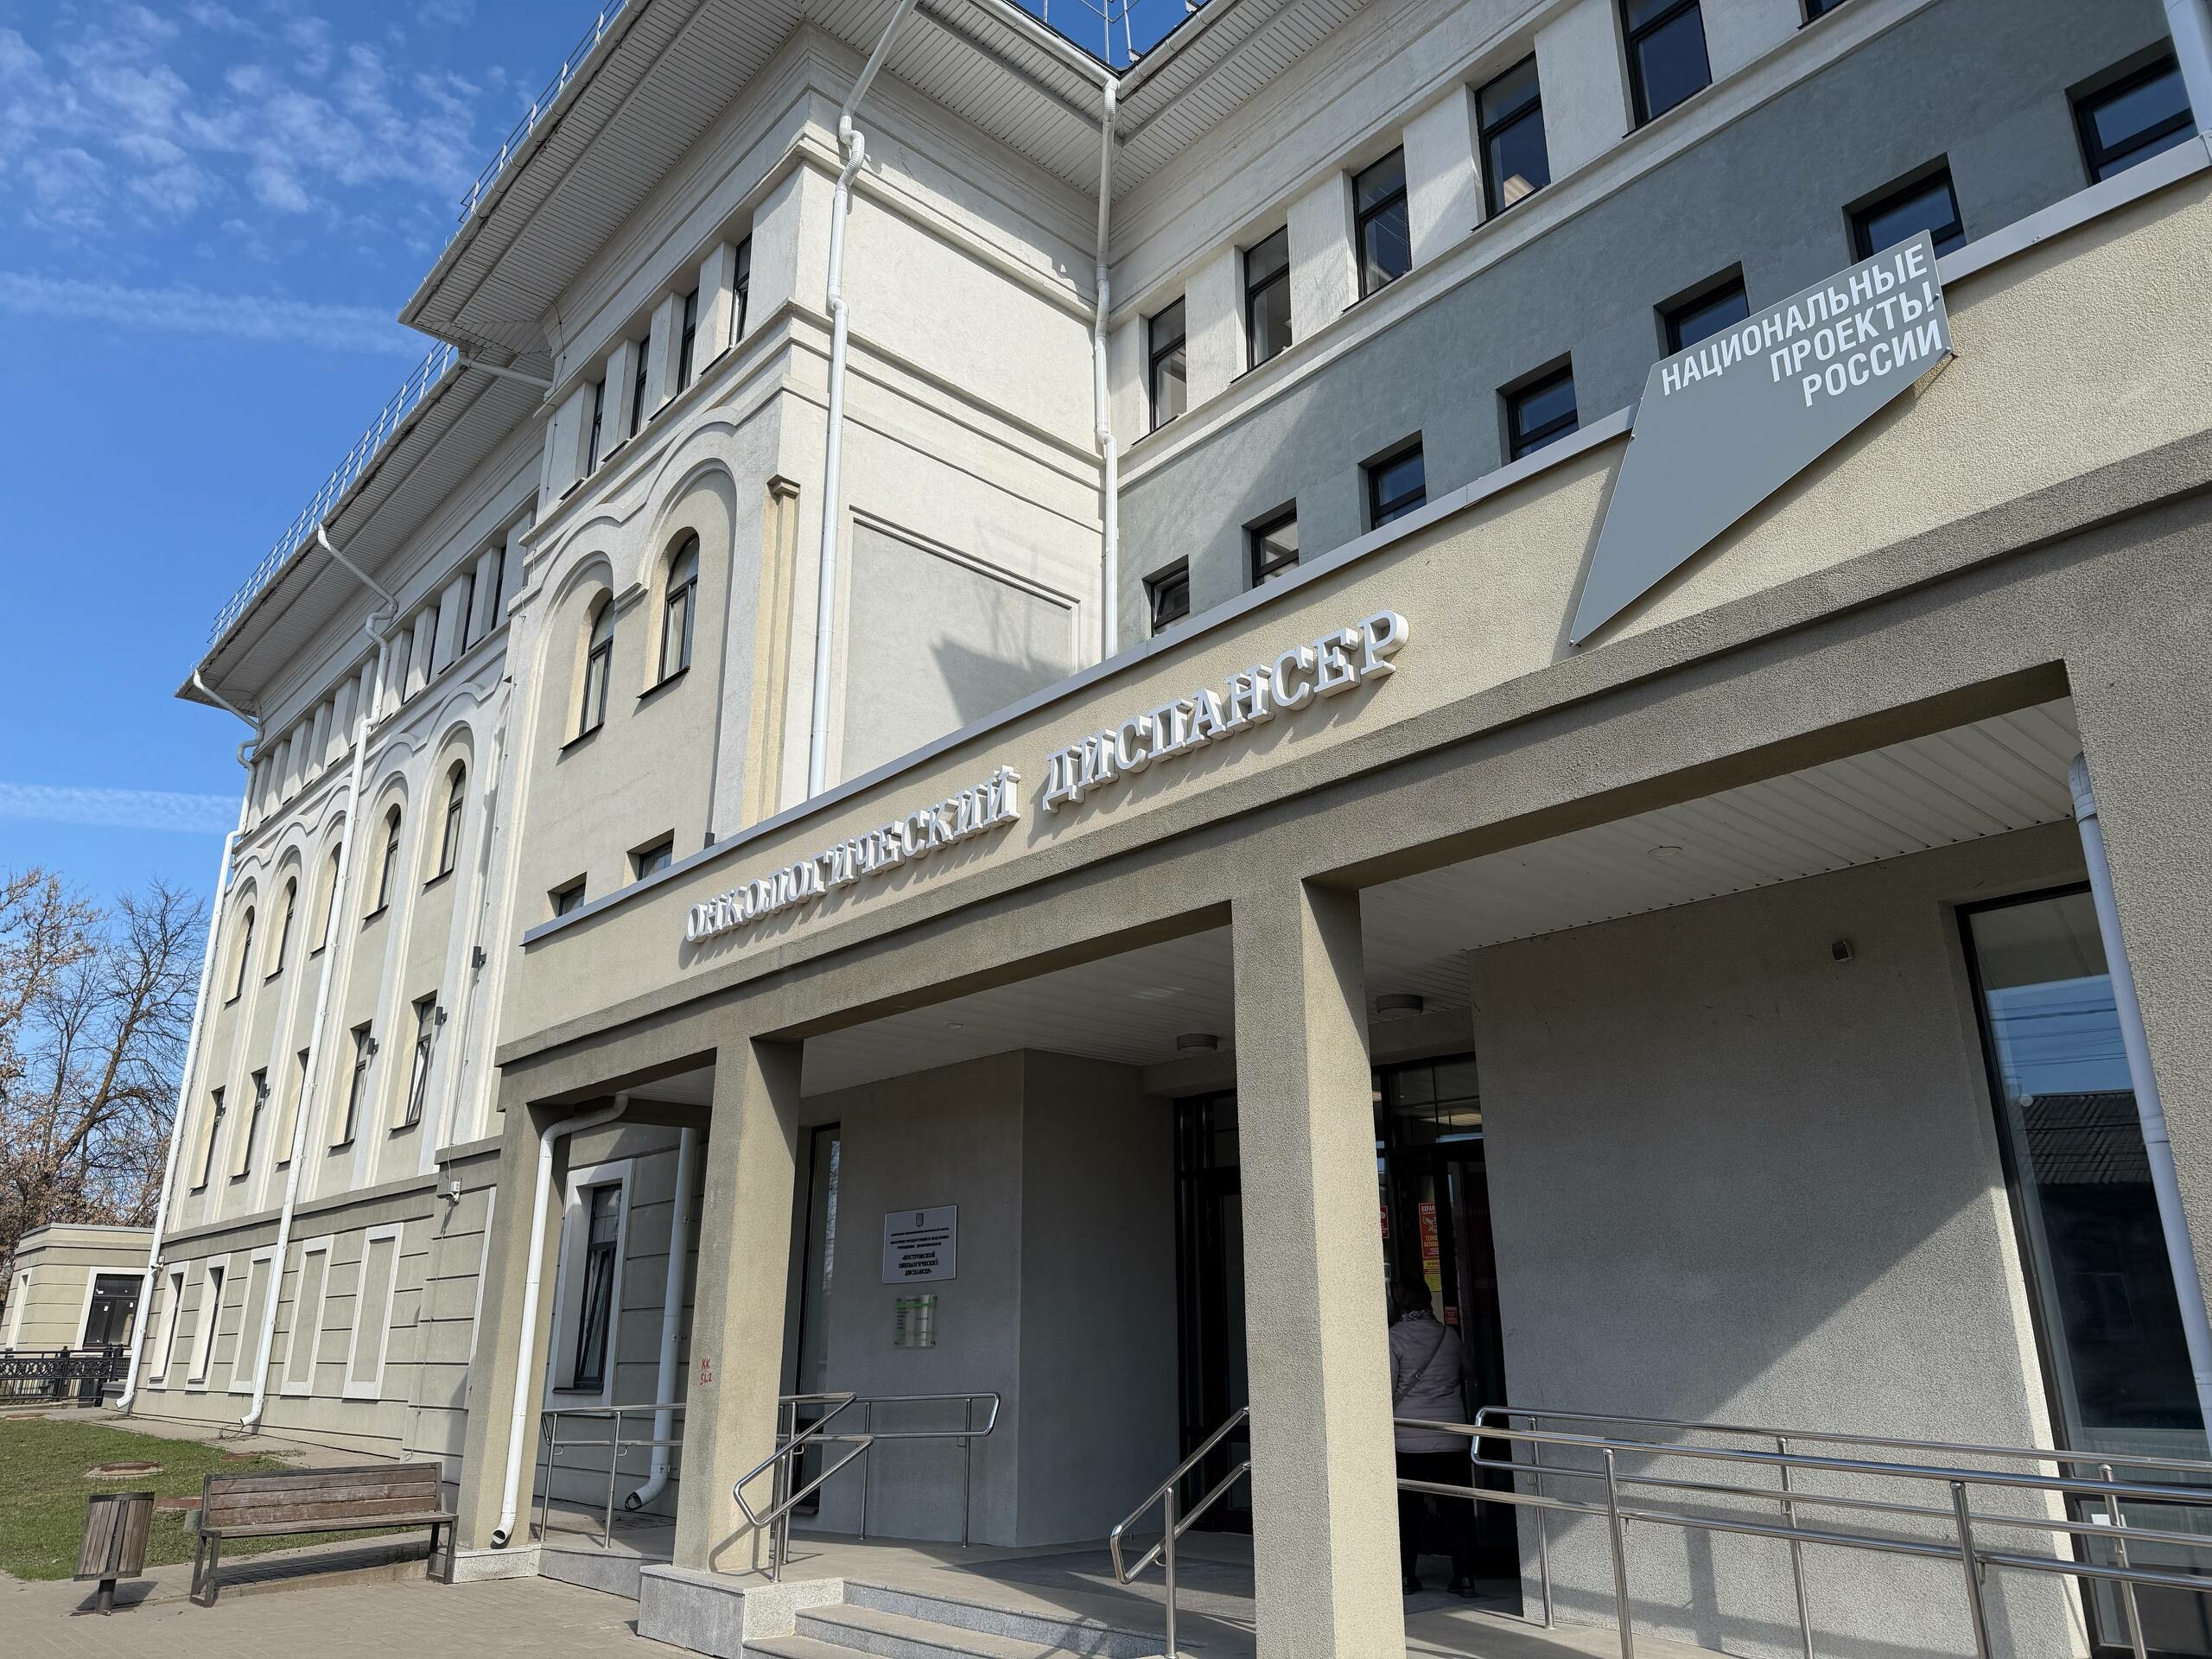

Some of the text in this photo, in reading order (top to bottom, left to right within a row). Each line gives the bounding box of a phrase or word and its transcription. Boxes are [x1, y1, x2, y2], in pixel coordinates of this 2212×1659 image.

[1662, 243, 1928, 396] НАЦИОНАЛЬНЫЕ
[1770, 281, 1935, 383] ПРОЕКТЫ
[1802, 319, 1943, 408] РОССИИ
[685, 609, 1409, 944] ОНКОЛОГИЧЕСКИЙ ДИСПАНСЕР
